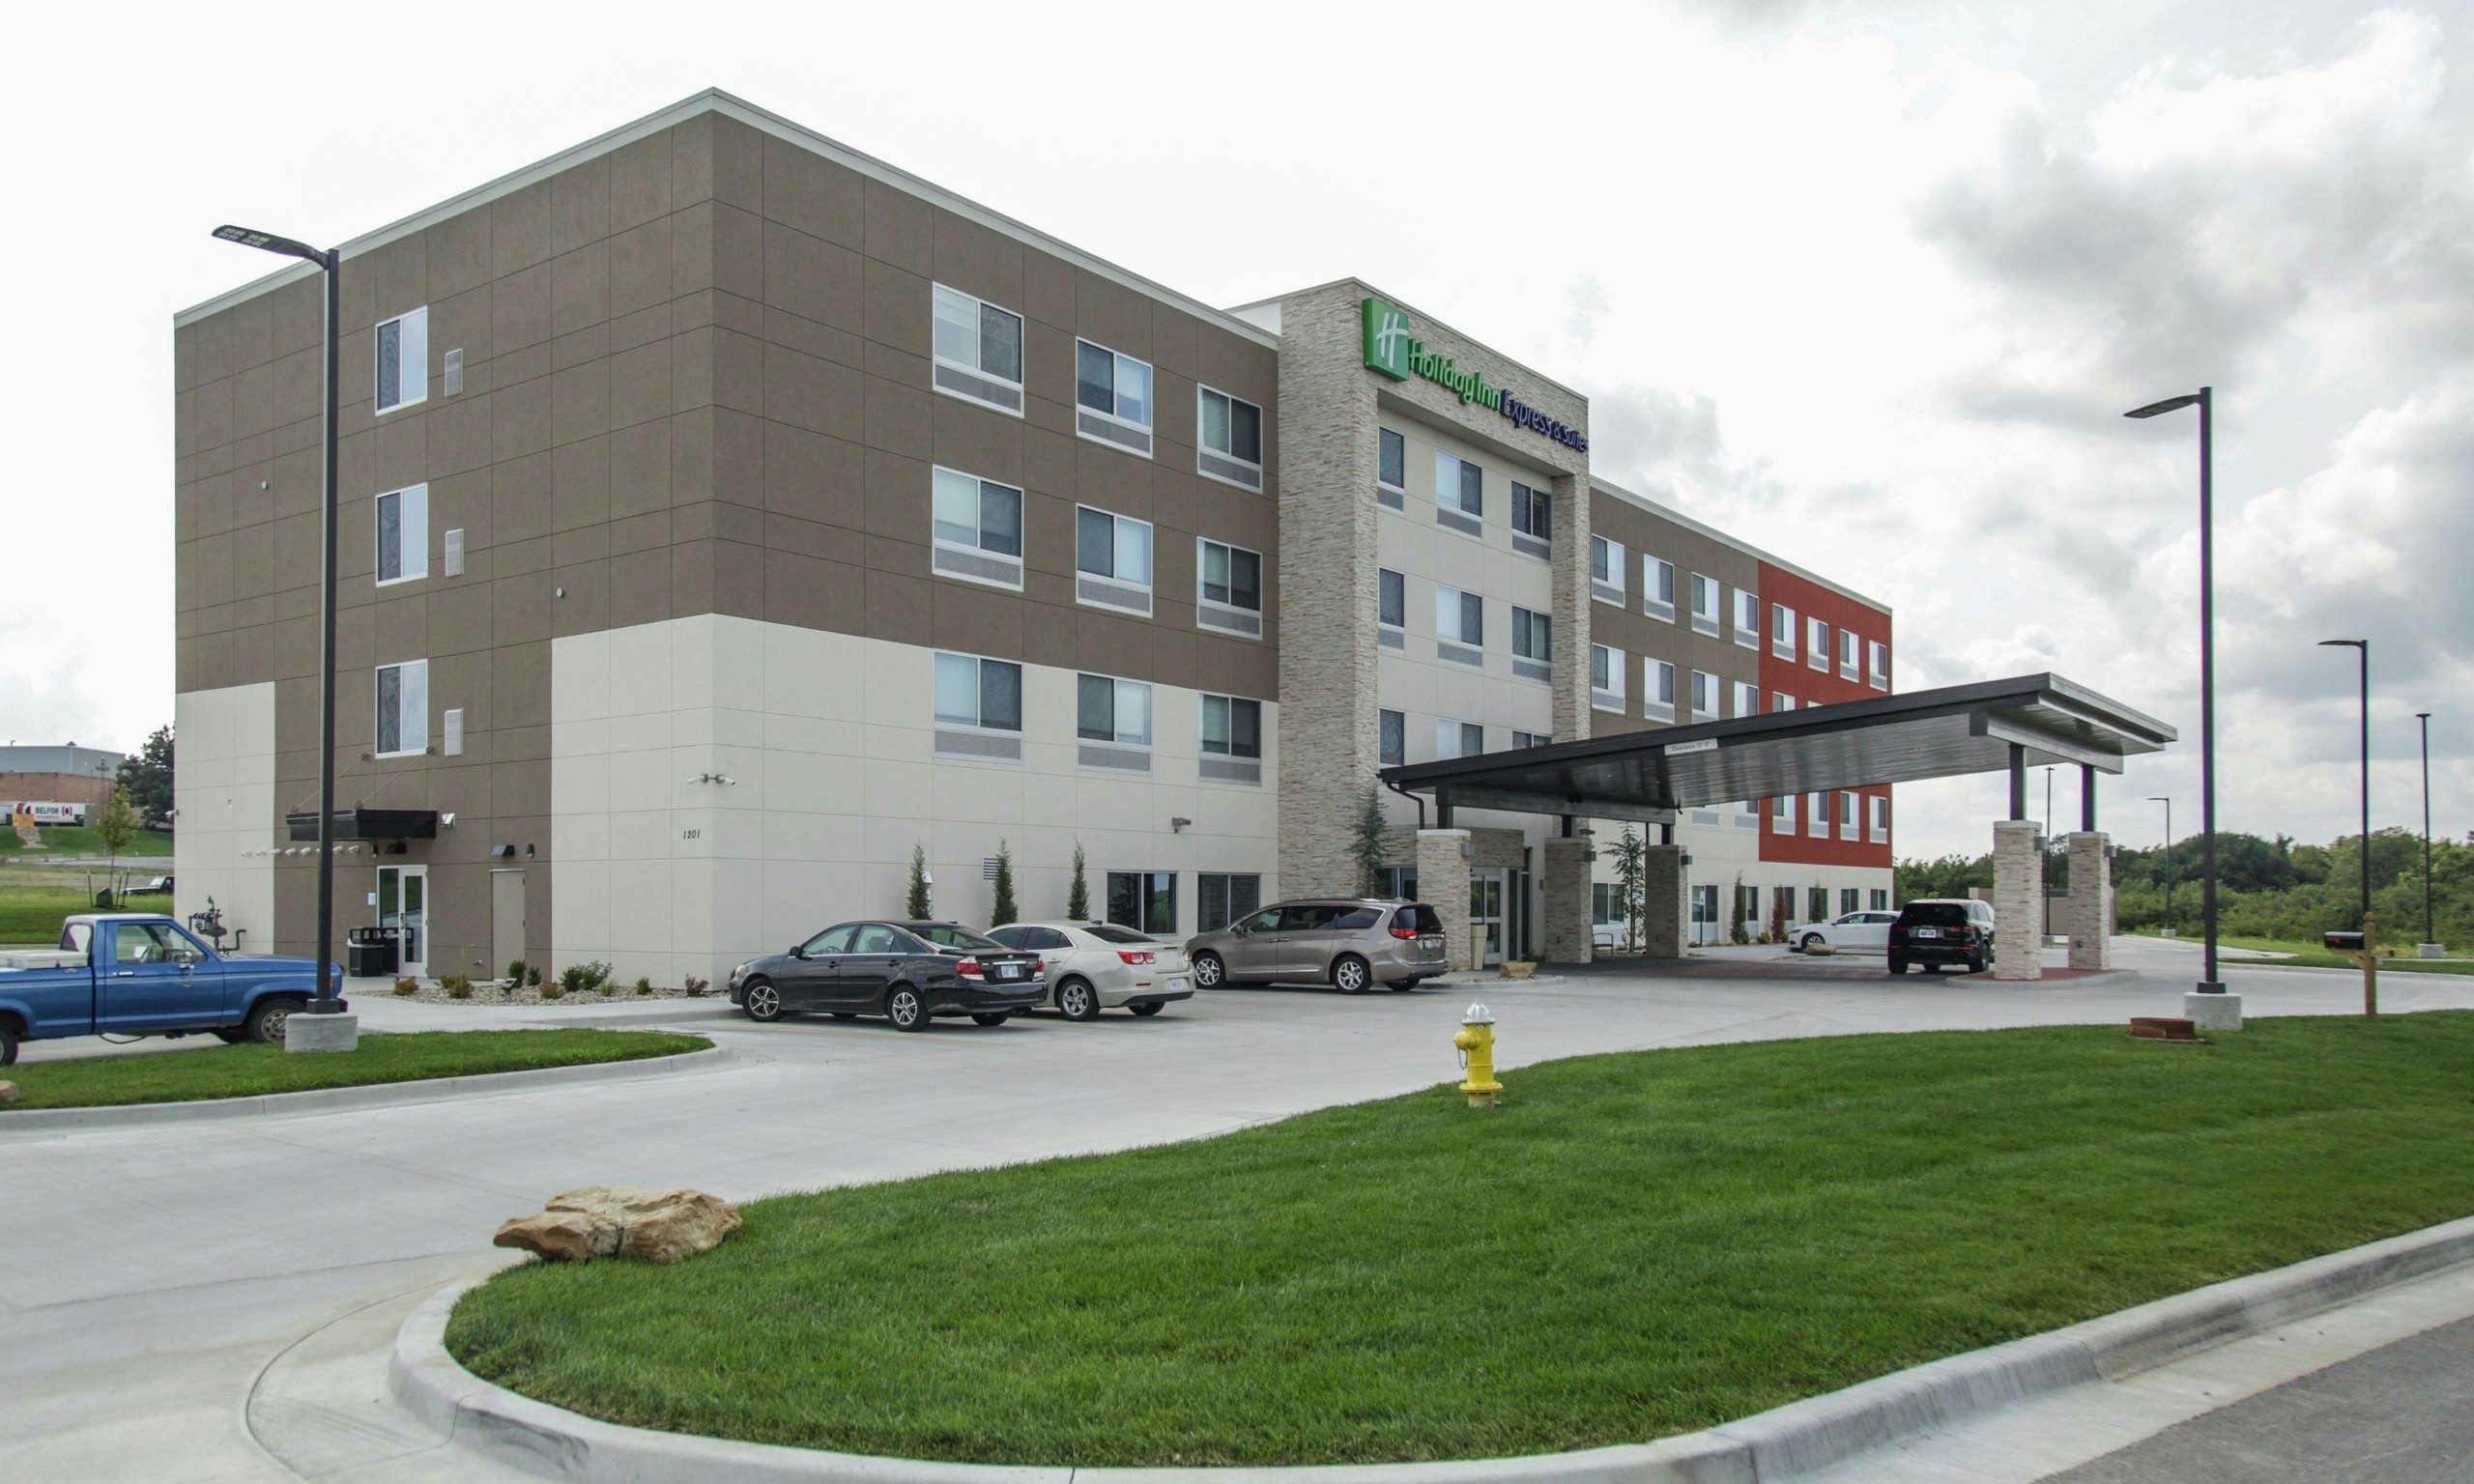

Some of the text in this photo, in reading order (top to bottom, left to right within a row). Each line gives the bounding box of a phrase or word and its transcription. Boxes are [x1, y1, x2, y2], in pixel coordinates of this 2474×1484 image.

[1408, 338, 1475, 404] Holiday
[1475, 371, 1501, 412] Inn
[1500, 389, 1552, 434] Express
[1551, 422, 1562, 442] &
[683, 830, 700, 839] 1201
